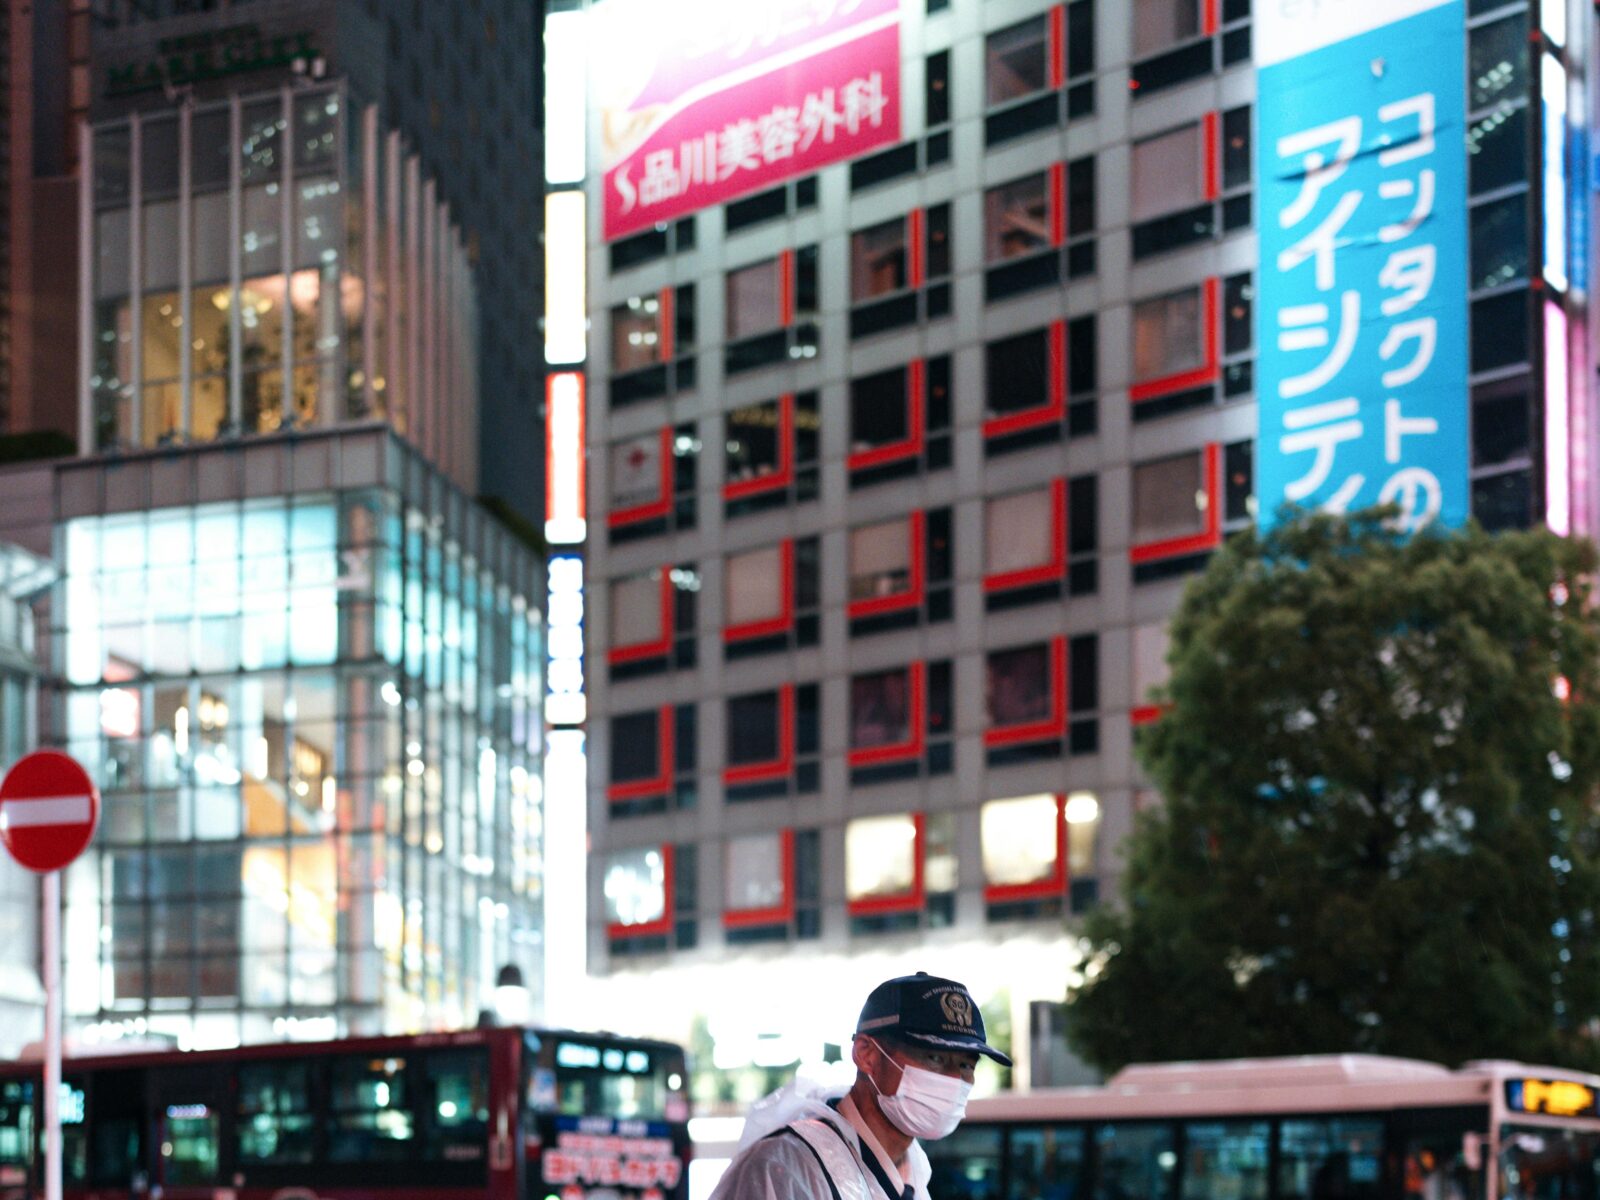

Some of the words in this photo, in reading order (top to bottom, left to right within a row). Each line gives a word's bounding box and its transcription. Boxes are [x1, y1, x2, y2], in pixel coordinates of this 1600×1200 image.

[638, 70, 888, 206] 品川美容外科
[1377, 92, 1442, 534] コンタクトの
